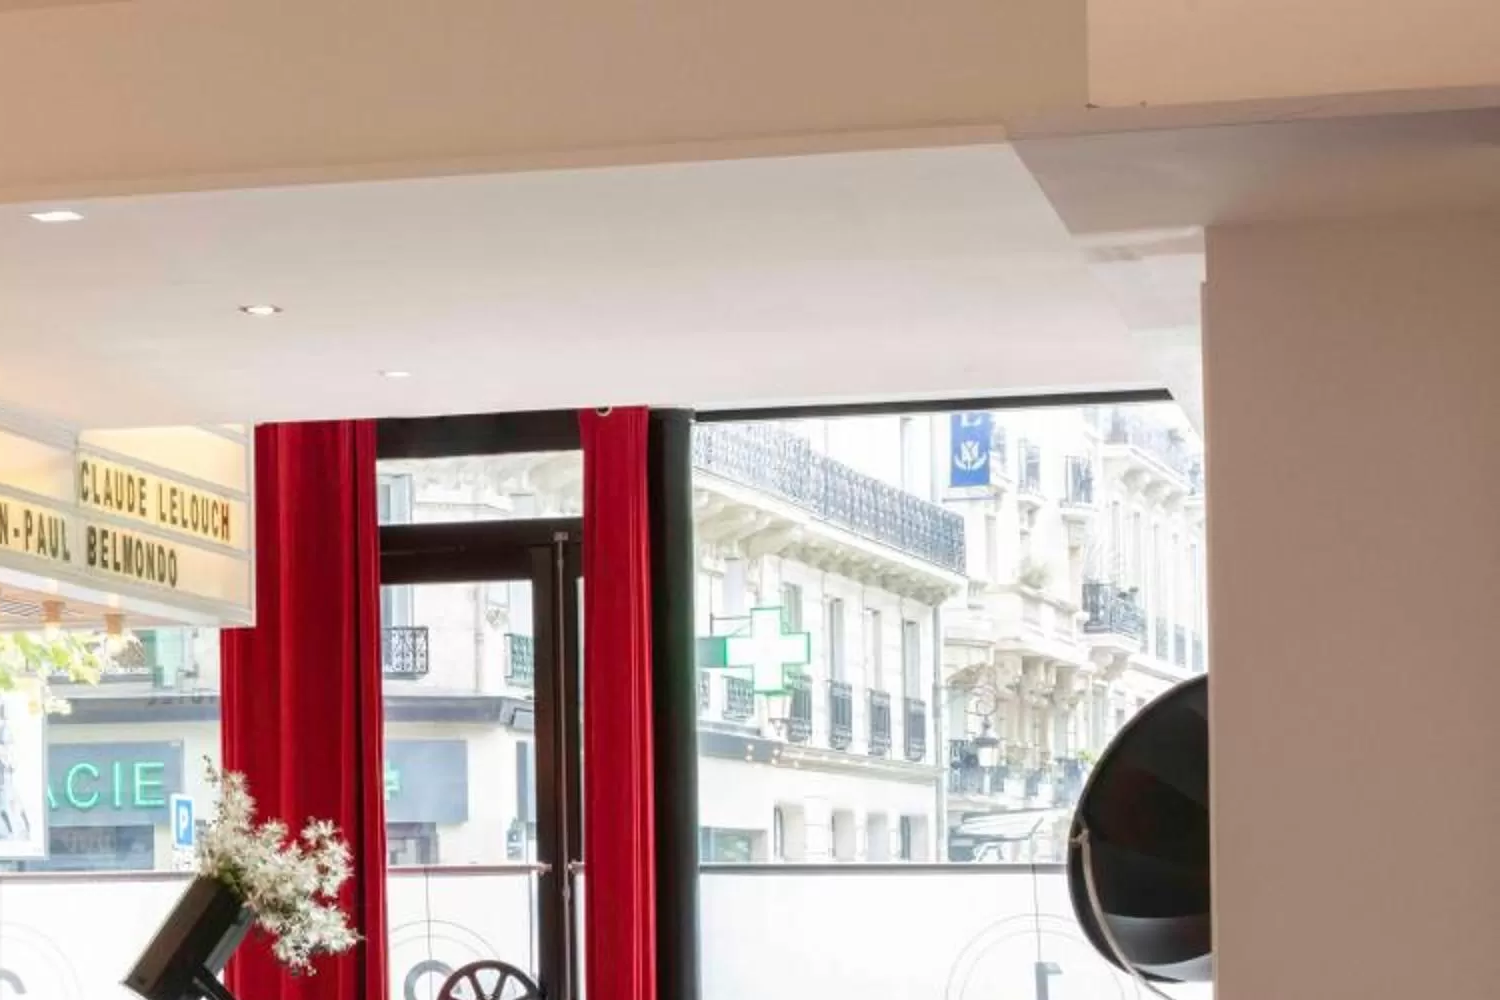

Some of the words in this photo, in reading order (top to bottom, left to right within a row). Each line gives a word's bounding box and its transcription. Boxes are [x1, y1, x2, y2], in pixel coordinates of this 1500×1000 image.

[80, 460, 147, 517] CLAUDE
[159, 483, 231, 542] LELOUCH
[87, 525, 178, 588] BELMONDO
